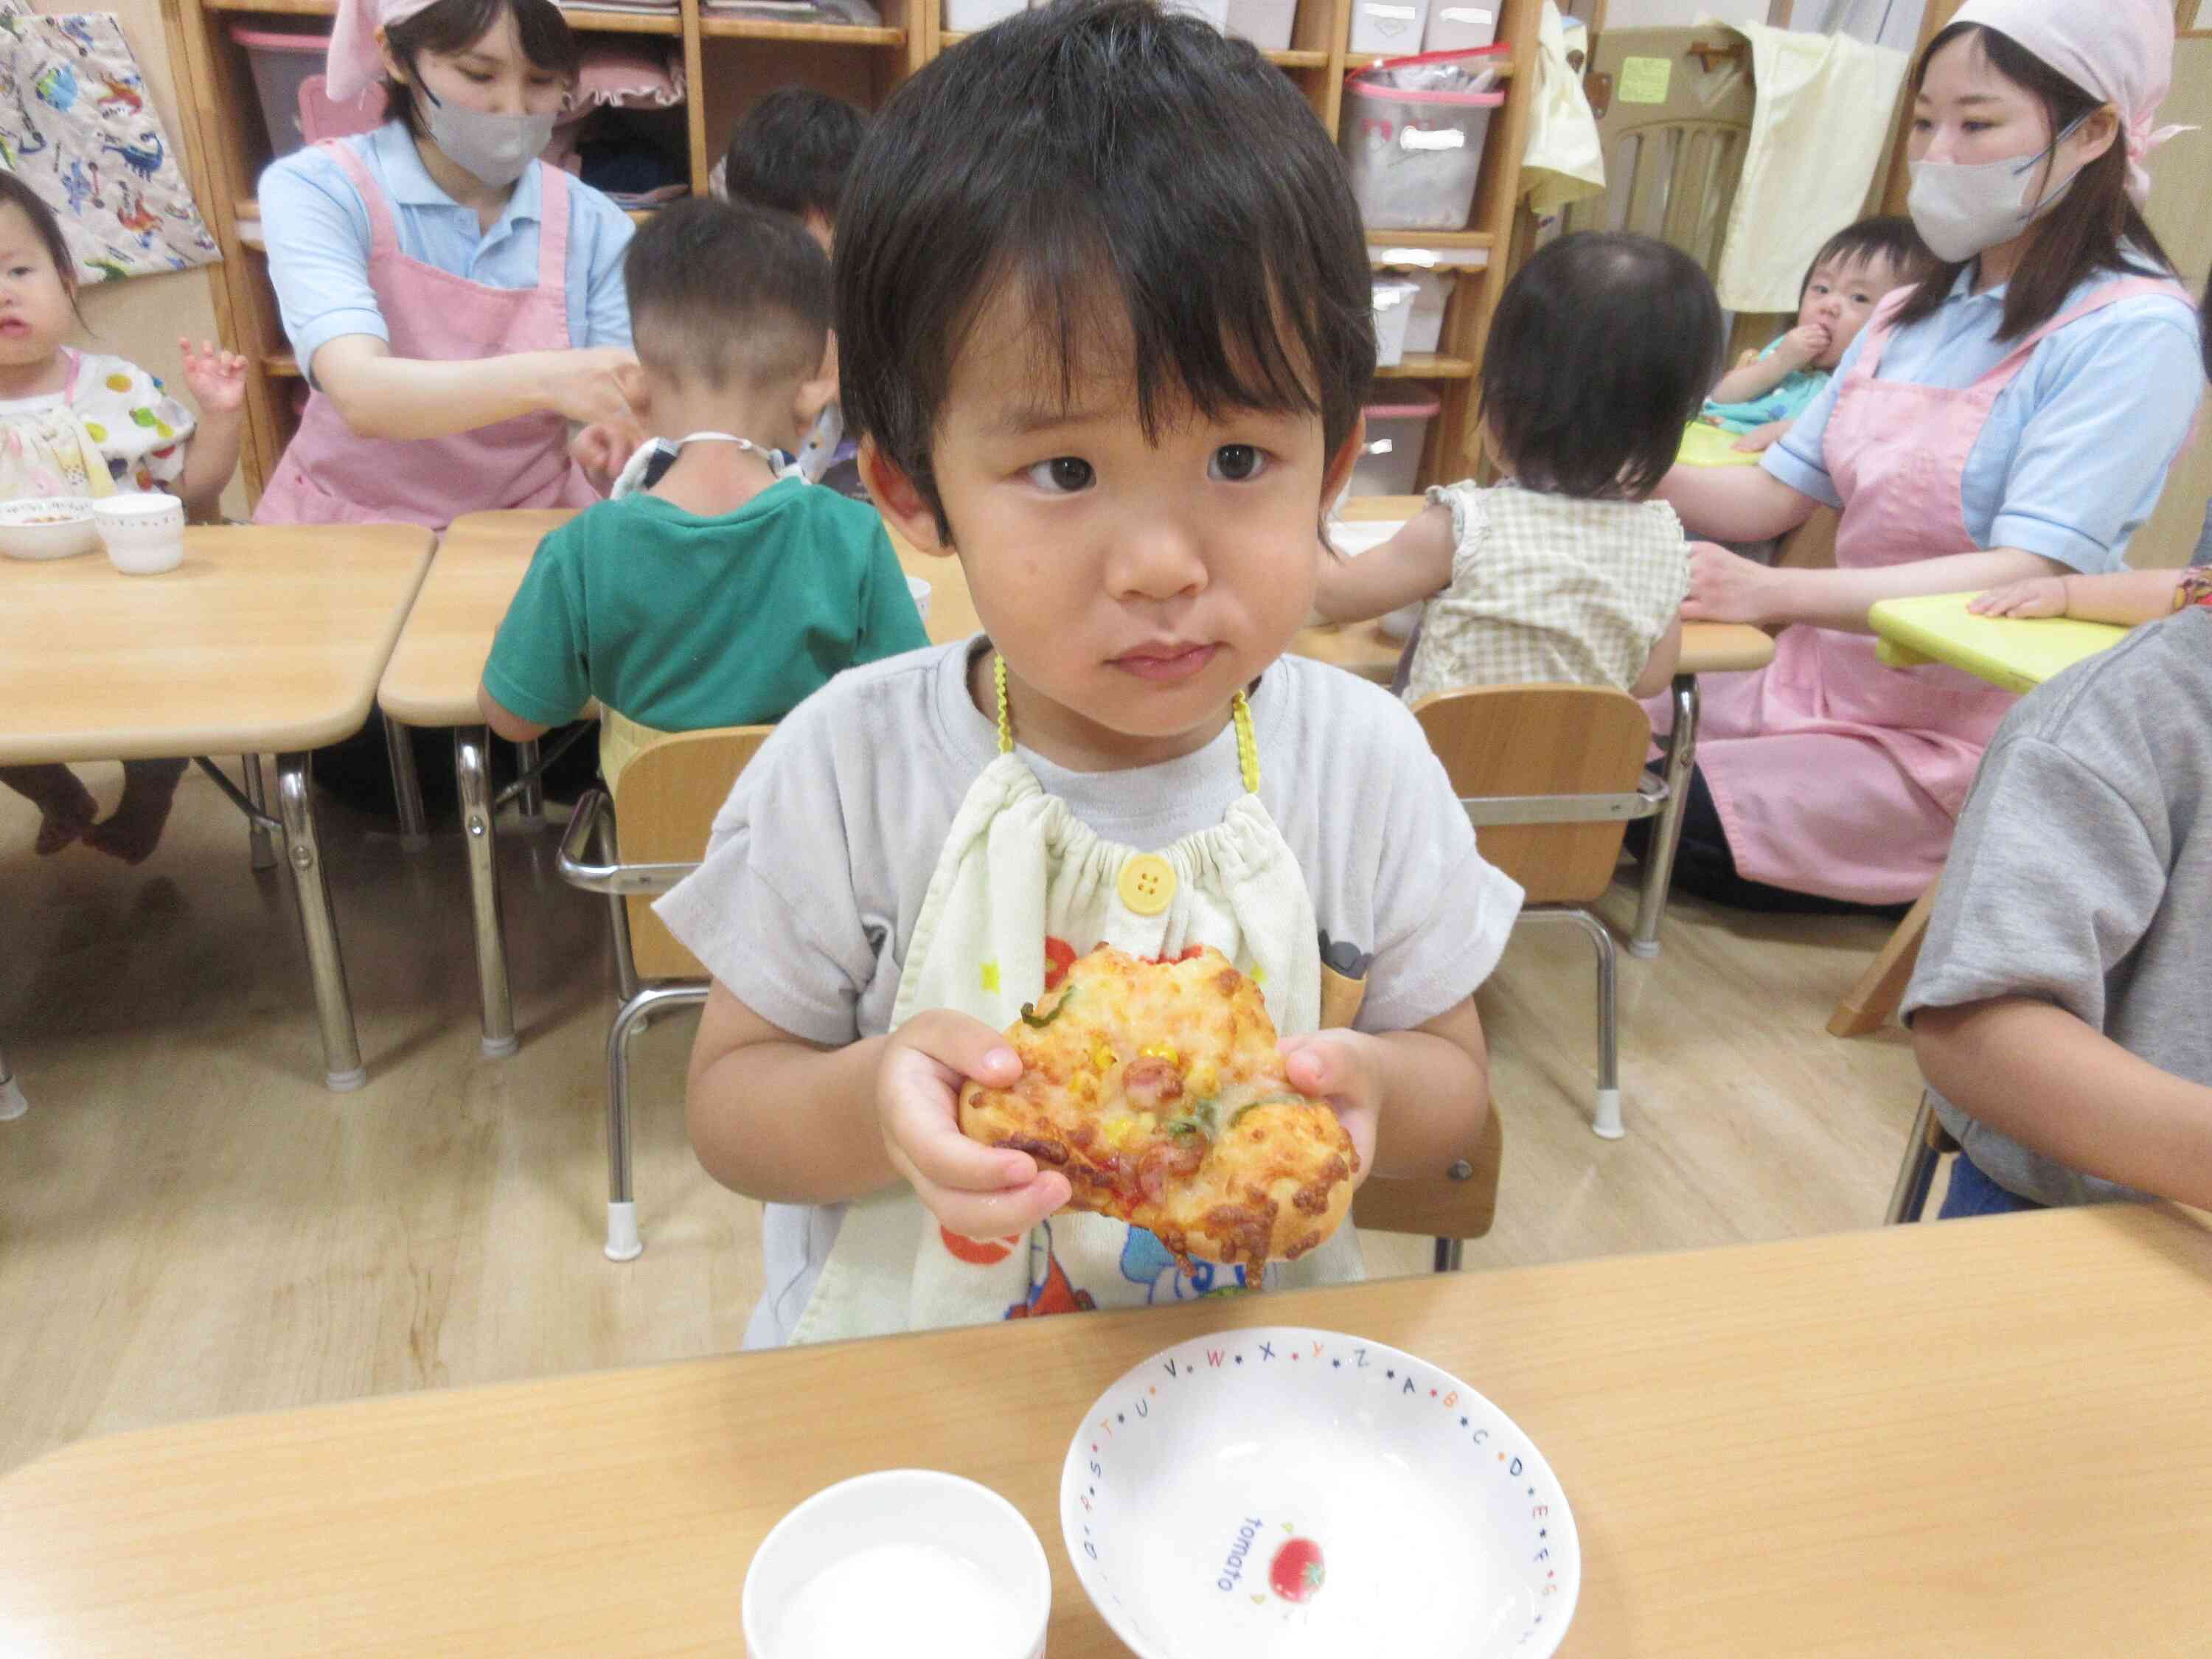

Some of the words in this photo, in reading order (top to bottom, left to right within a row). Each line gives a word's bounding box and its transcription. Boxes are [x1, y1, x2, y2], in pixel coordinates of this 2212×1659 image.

[1090, 1461, 1101, 1478] S
[1100, 1416, 1113, 1437] T
[1135, 1399, 1148, 1418] U
[1164, 1358, 1177, 1377] V
[1206, 1346, 1225, 1368] W
[1259, 1341, 1276, 1362] X
[1312, 1340, 1324, 1357] Y
[1354, 1349, 1370, 1368] Z
[1403, 1377, 1416, 1394] A
[1443, 1391, 1458, 1409] B
[1472, 1428, 1489, 1445] C
[1509, 1457, 1523, 1477] D
[1532, 1505, 1548, 1519] E
[1217, 1517, 1263, 1592] tomato
